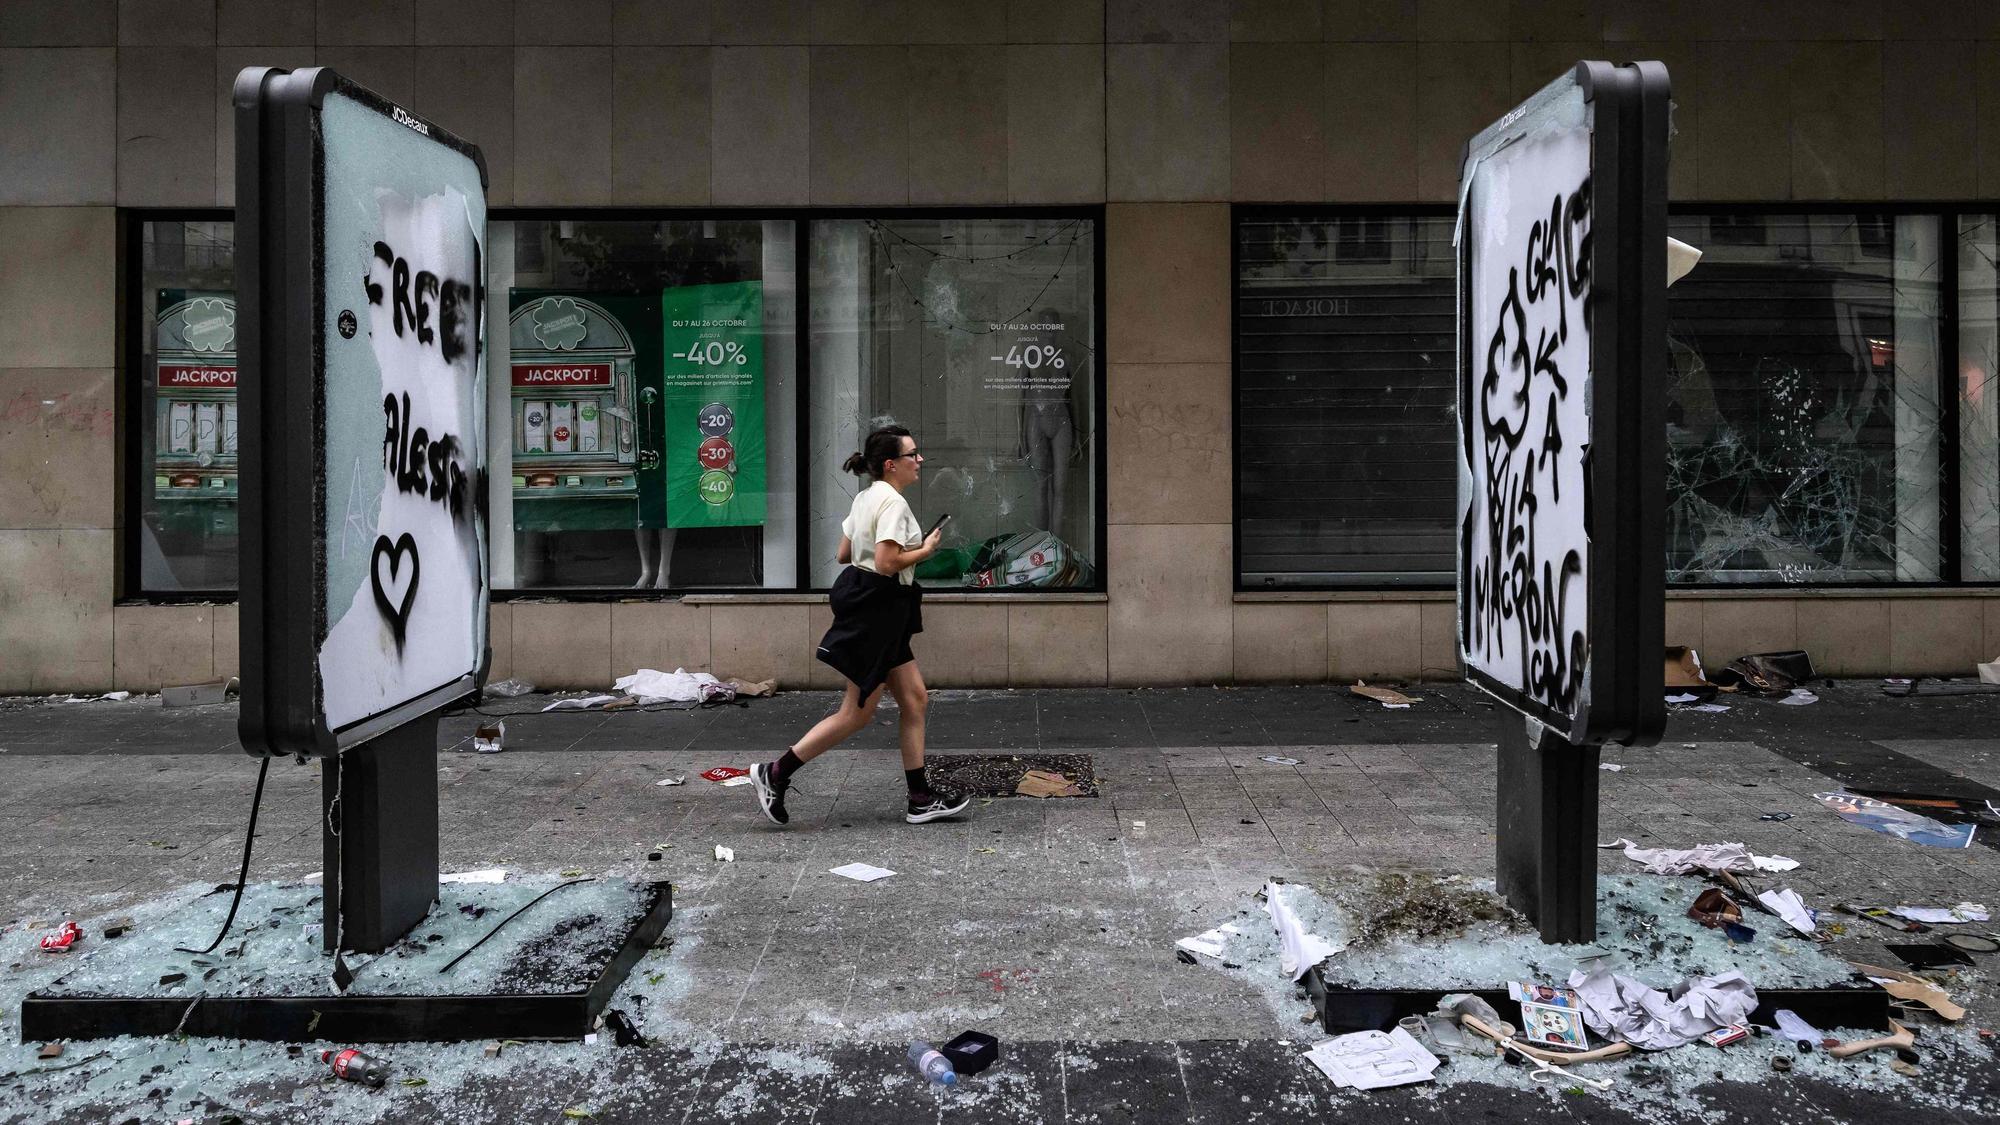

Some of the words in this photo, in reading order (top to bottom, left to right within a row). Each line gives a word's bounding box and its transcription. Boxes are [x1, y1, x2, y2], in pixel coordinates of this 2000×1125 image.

[392, 106, 429, 136] JCDecaux
[672, 341, 747, 365] -40%
[990, 345, 1065, 369] -40%
[524, 369, 591, 382] JACKPOT
